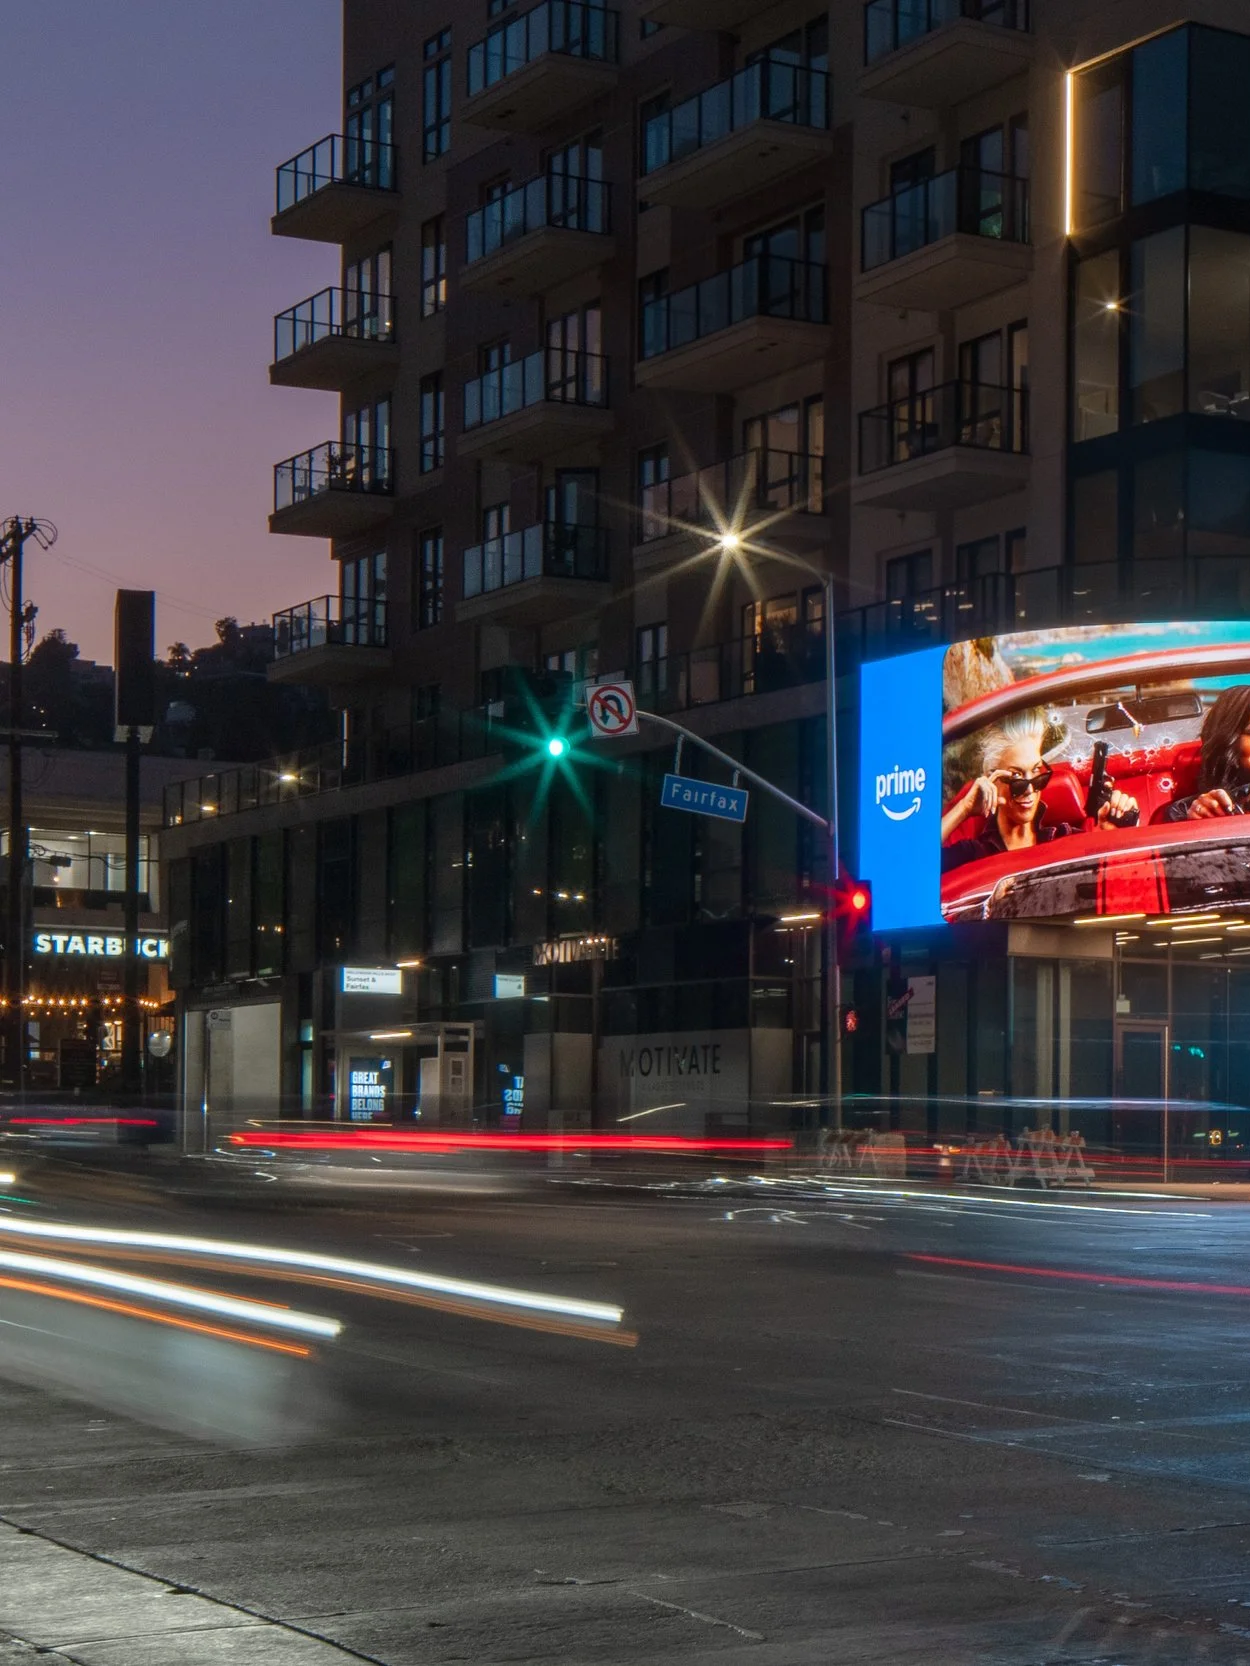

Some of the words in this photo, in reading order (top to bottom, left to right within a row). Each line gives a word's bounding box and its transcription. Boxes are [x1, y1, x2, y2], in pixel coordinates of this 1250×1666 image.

[875, 764, 926, 805] prime
[671, 783, 738, 812] Fairfax
[346, 975, 370, 983] Sunset
[620, 1044, 721, 1077] MOTIVATE
[351, 1071, 379, 1085] GREAT
[351, 1085, 386, 1098] BRANDS
[351, 1098, 385, 1111] BELONG
